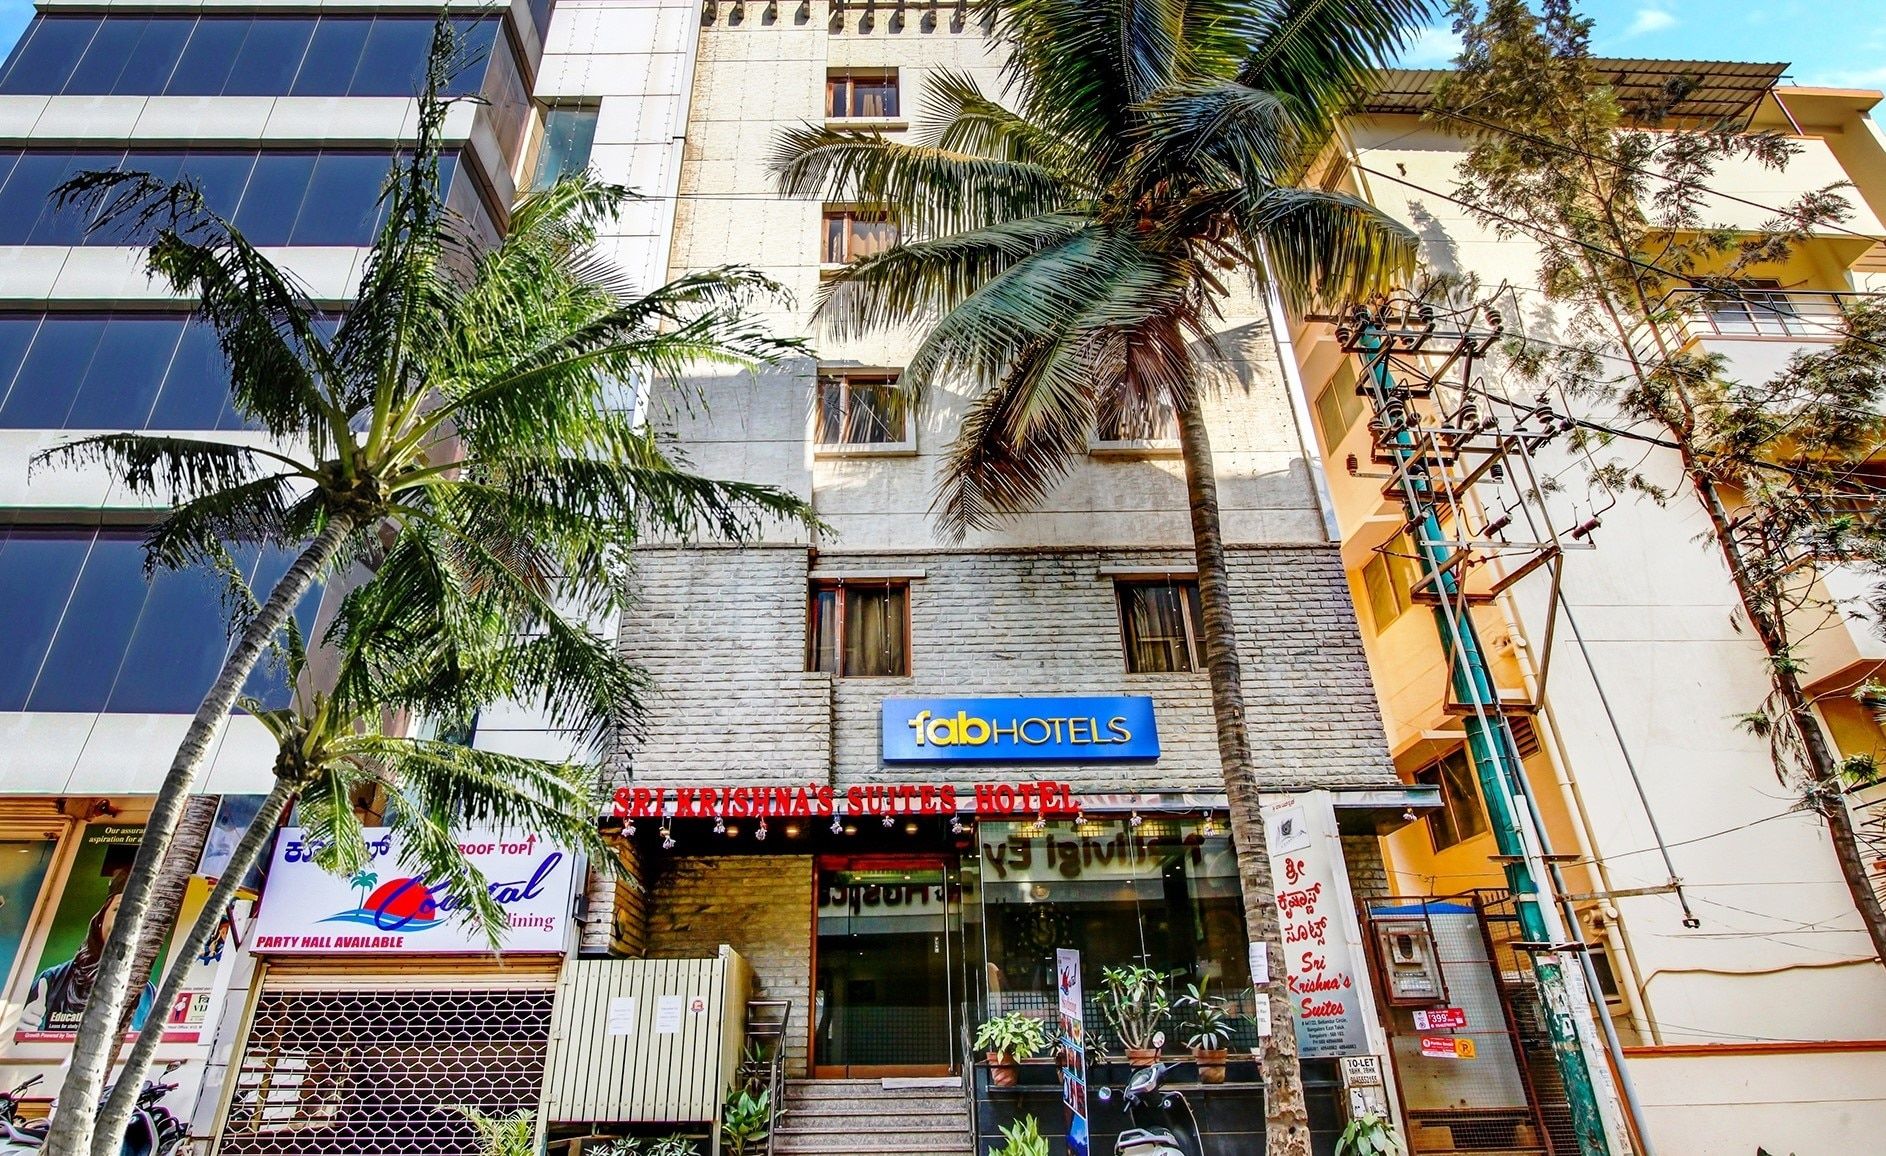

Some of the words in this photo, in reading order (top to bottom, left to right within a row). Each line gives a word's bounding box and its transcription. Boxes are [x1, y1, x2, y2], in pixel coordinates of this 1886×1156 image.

[613, 787, 666, 817] SRI
[675, 782, 833, 817] KRISHNA'S
[847, 784, 957, 815] SUITES
[974, 780, 1079, 814] HOTEL
[104, 826, 121, 834] Our
[89, 835, 124, 844] aspiration
[125, 835, 139, 843] for
[456, 843, 495, 855] ROOF
[500, 842, 528, 855] TOP
[374, 852, 563, 931] Coaal
[256, 936, 299, 948] PARTY
[300, 936, 331, 948] HALL
[334, 936, 404, 948] AVAILABLE
[1301, 951, 1326, 973] Sri
[1287, 972, 1352, 995] Krishna's
[1300, 997, 1345, 1019] Suites
[1347, 1058, 1374, 1067] TO-LET
